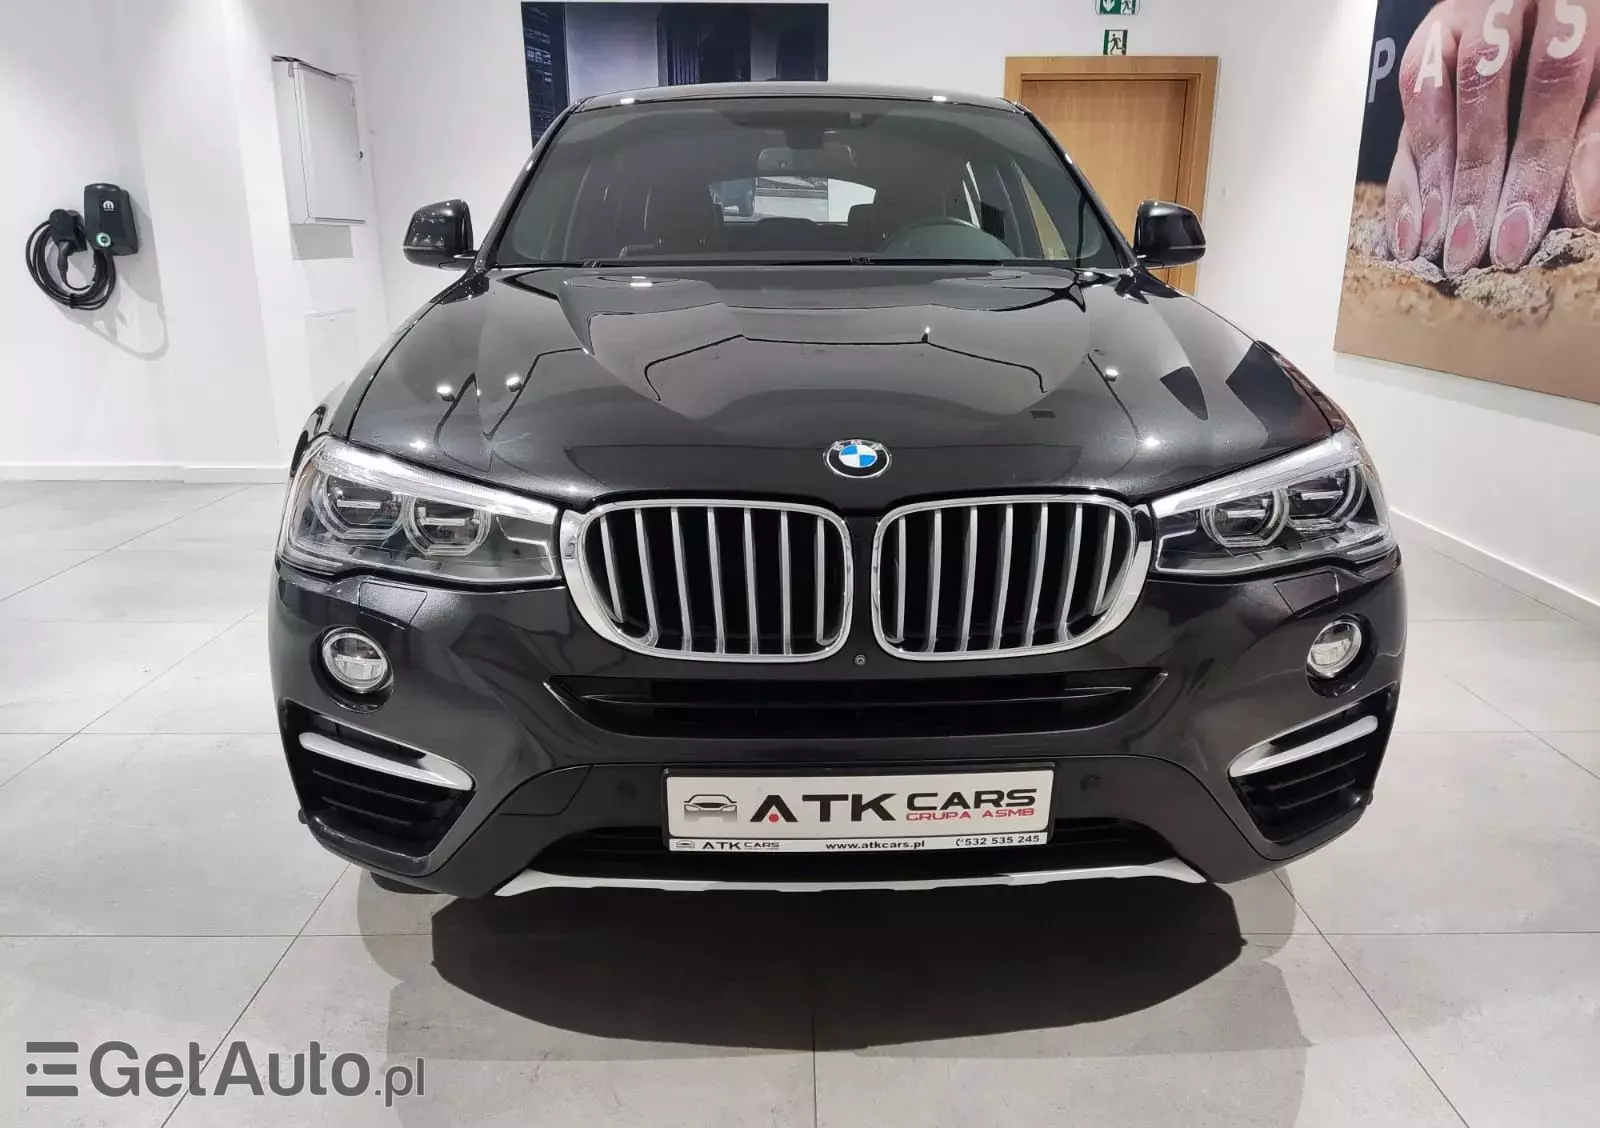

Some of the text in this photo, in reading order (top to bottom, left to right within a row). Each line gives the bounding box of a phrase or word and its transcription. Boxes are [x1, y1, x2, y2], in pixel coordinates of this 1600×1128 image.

[749, 788, 1037, 823] ATK CARS
[905, 808, 1035, 822] GRUPA ASMB
[702, 841, 741, 851] ATK
[743, 841, 780, 849] CARS
[825, 839, 925, 850] www.atkcars.pl
[991, 836, 1014, 846] 535
[1017, 834, 1040, 844] 245
